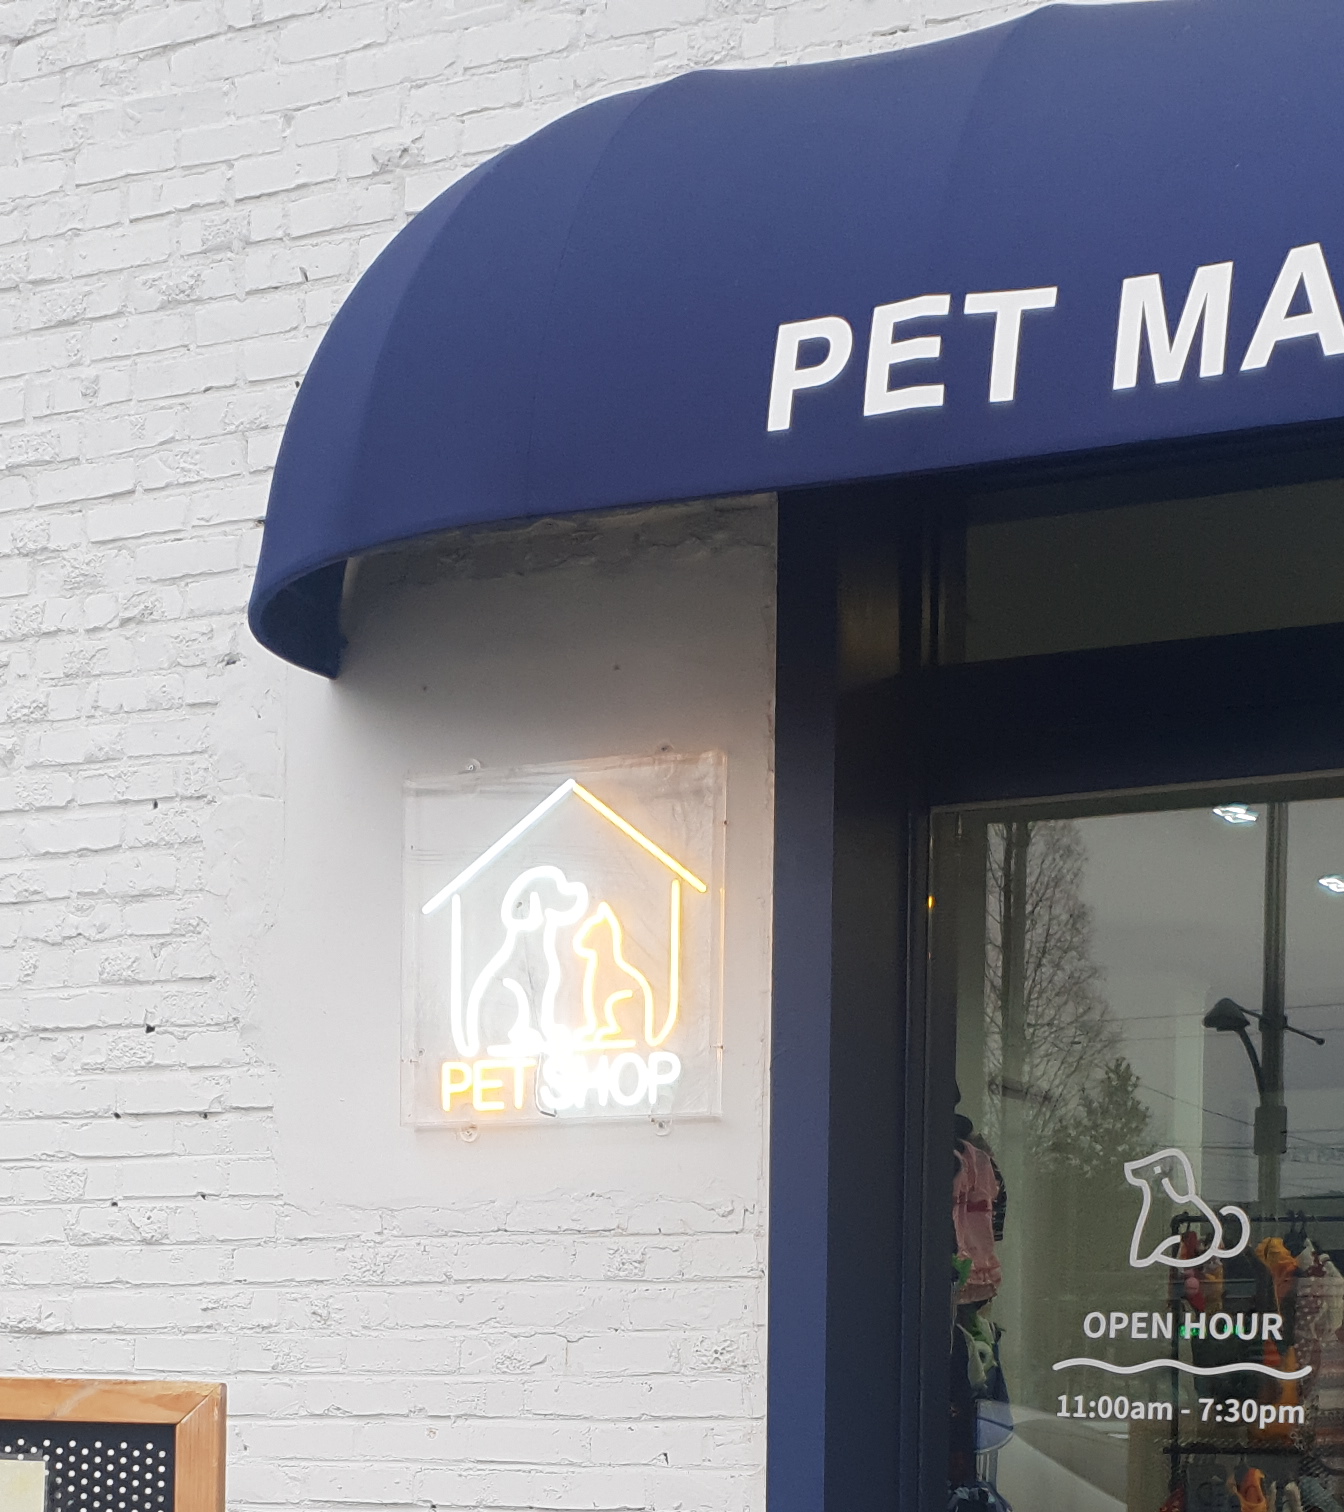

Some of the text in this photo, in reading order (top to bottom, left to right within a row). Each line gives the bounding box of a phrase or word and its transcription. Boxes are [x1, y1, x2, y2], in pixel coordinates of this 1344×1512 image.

[766, 286, 1058, 432] PET
[441, 1050, 682, 1112] PET SHOP
[1083, 1311, 1284, 1341] OPEN HOUR
[1056, 1394, 1173, 1421] 11:00am
[1198, 1397, 1305, 1427] 7:30pm
